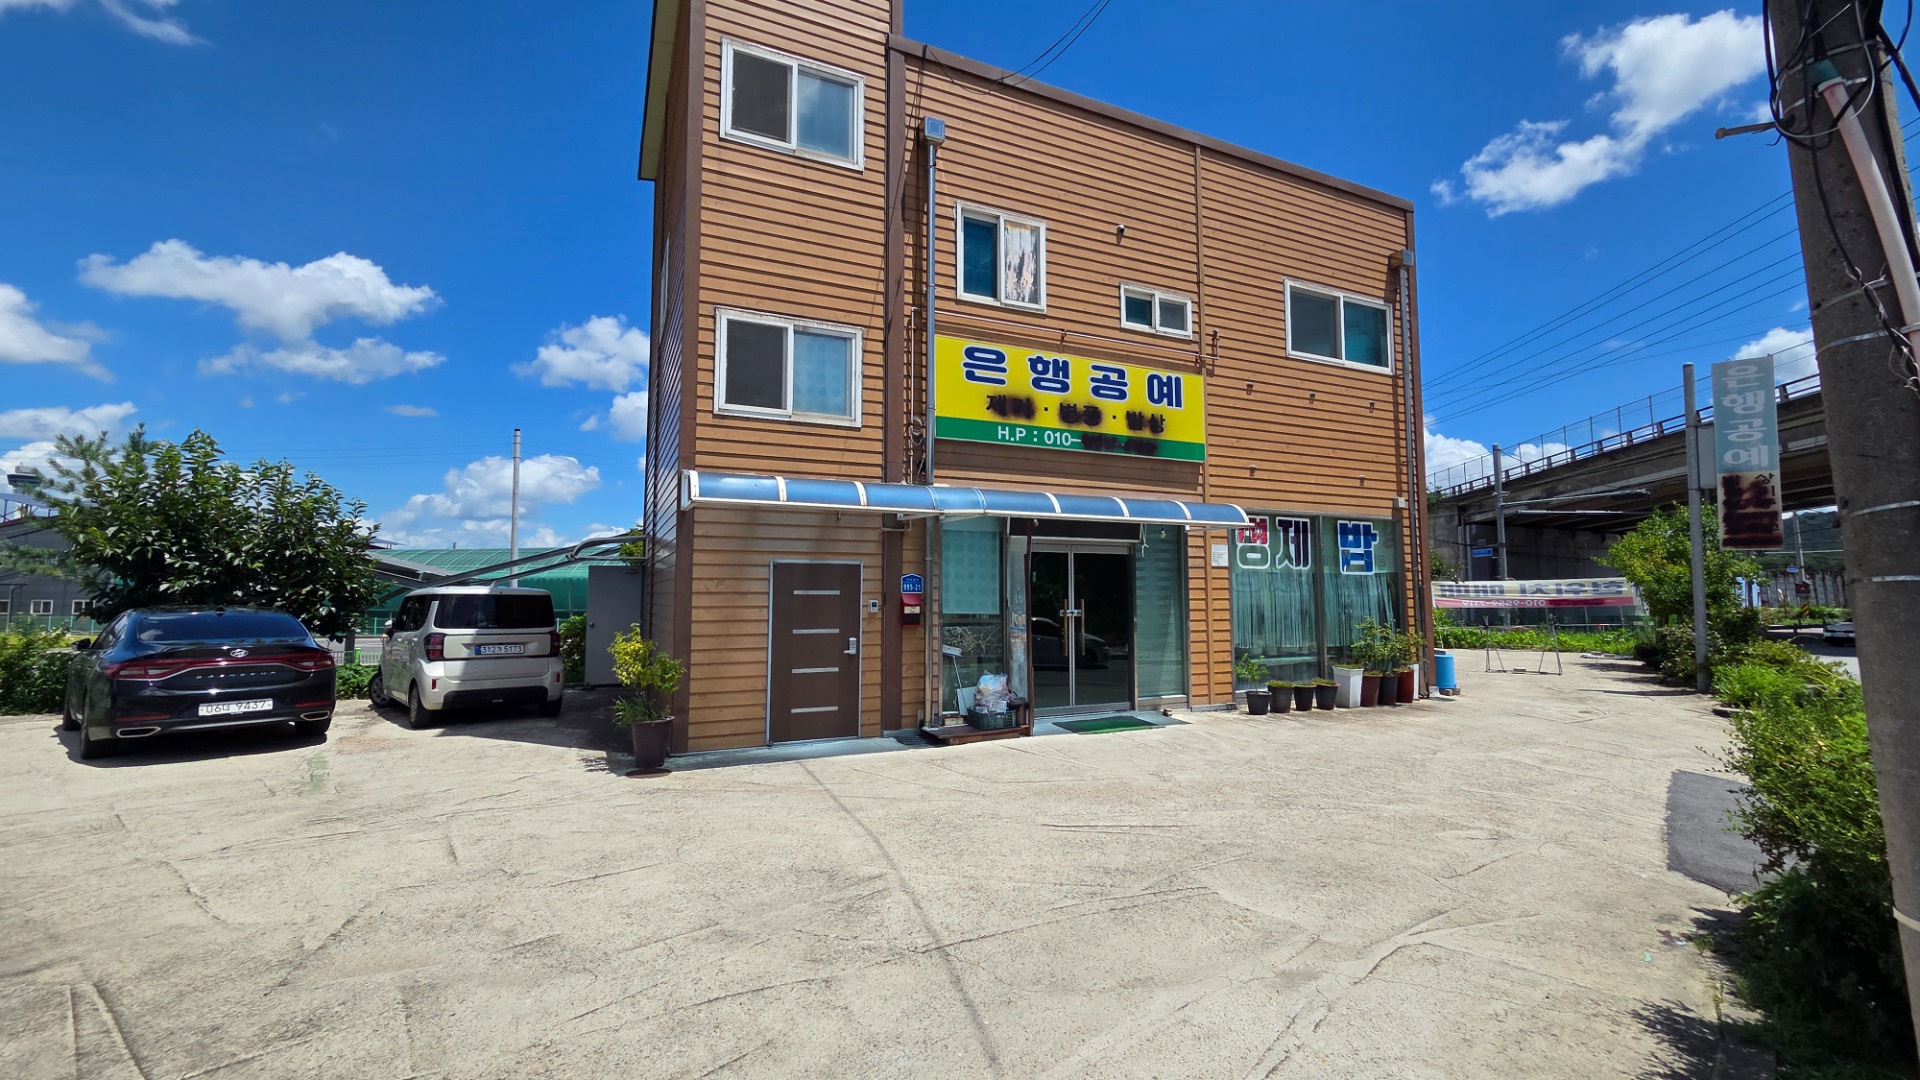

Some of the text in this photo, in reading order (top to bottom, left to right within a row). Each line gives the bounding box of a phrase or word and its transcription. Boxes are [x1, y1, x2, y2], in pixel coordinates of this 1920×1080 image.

[963, 345, 1184, 408] 은행공예
[997, 426, 1026, 441] H.P
[1721, 365, 1769, 468] 은행공예
[236, 700, 266, 711] 9437
